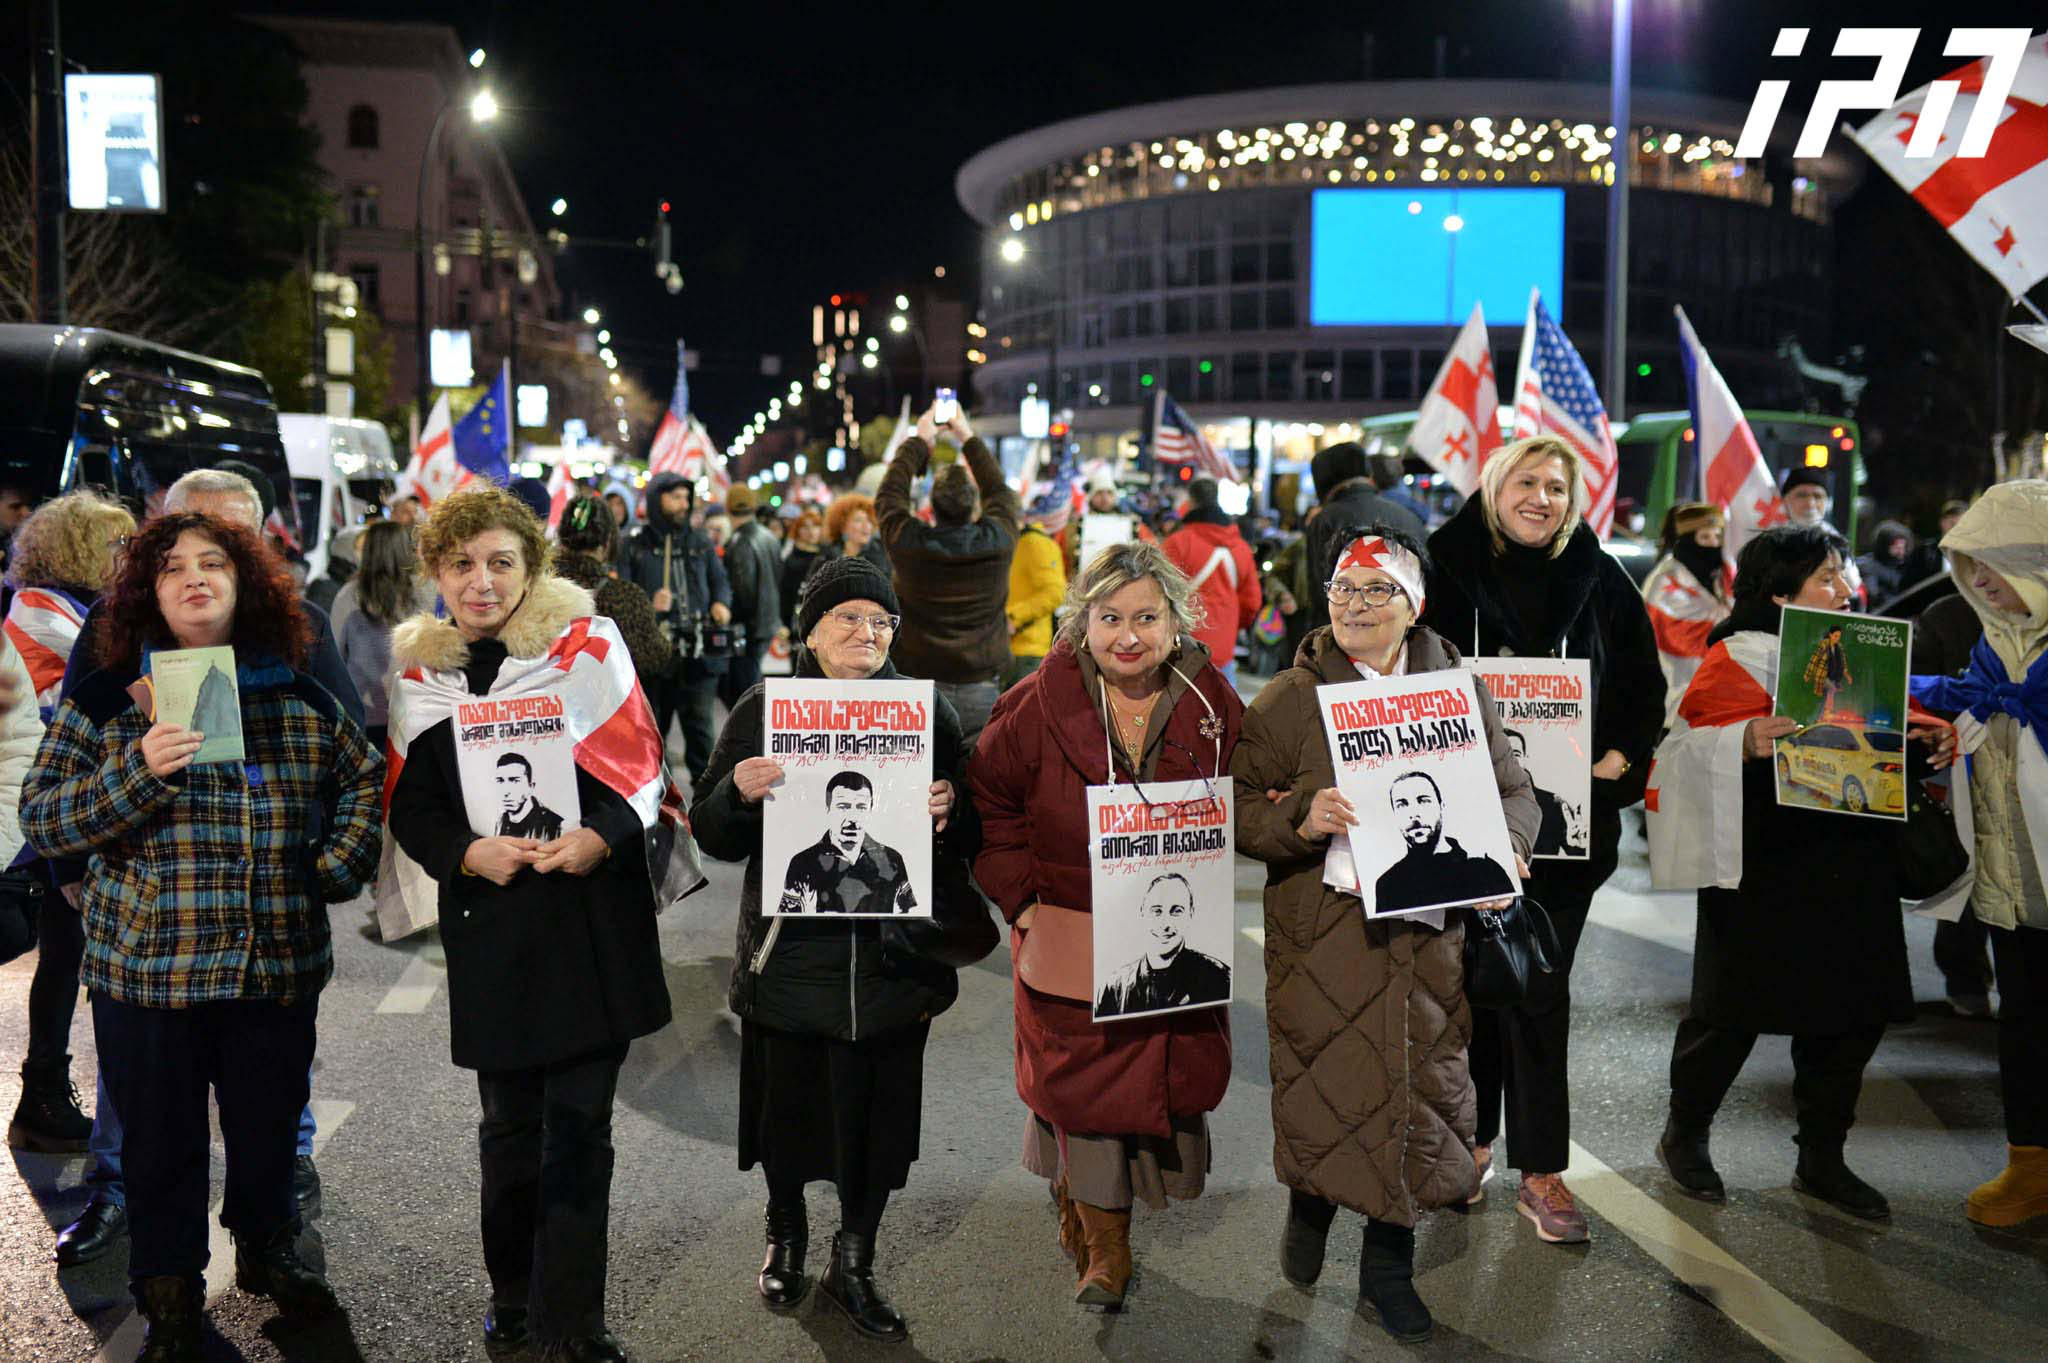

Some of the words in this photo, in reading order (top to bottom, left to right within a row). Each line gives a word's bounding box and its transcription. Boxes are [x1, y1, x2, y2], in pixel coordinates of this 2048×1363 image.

[458, 694, 564, 726] თავისუფლება
[771, 699, 927, 731] თავისუფლება
[1331, 687, 1471, 731] თავისუფლება
[772, 733, 831, 754] გიორგი
[835, 733, 925, 755] ტერიშვილს
[1338, 728, 1393, 762] გელა
[1396, 718, 1476, 755] ხასაიას
[1101, 835, 1158, 860] გიორგი
